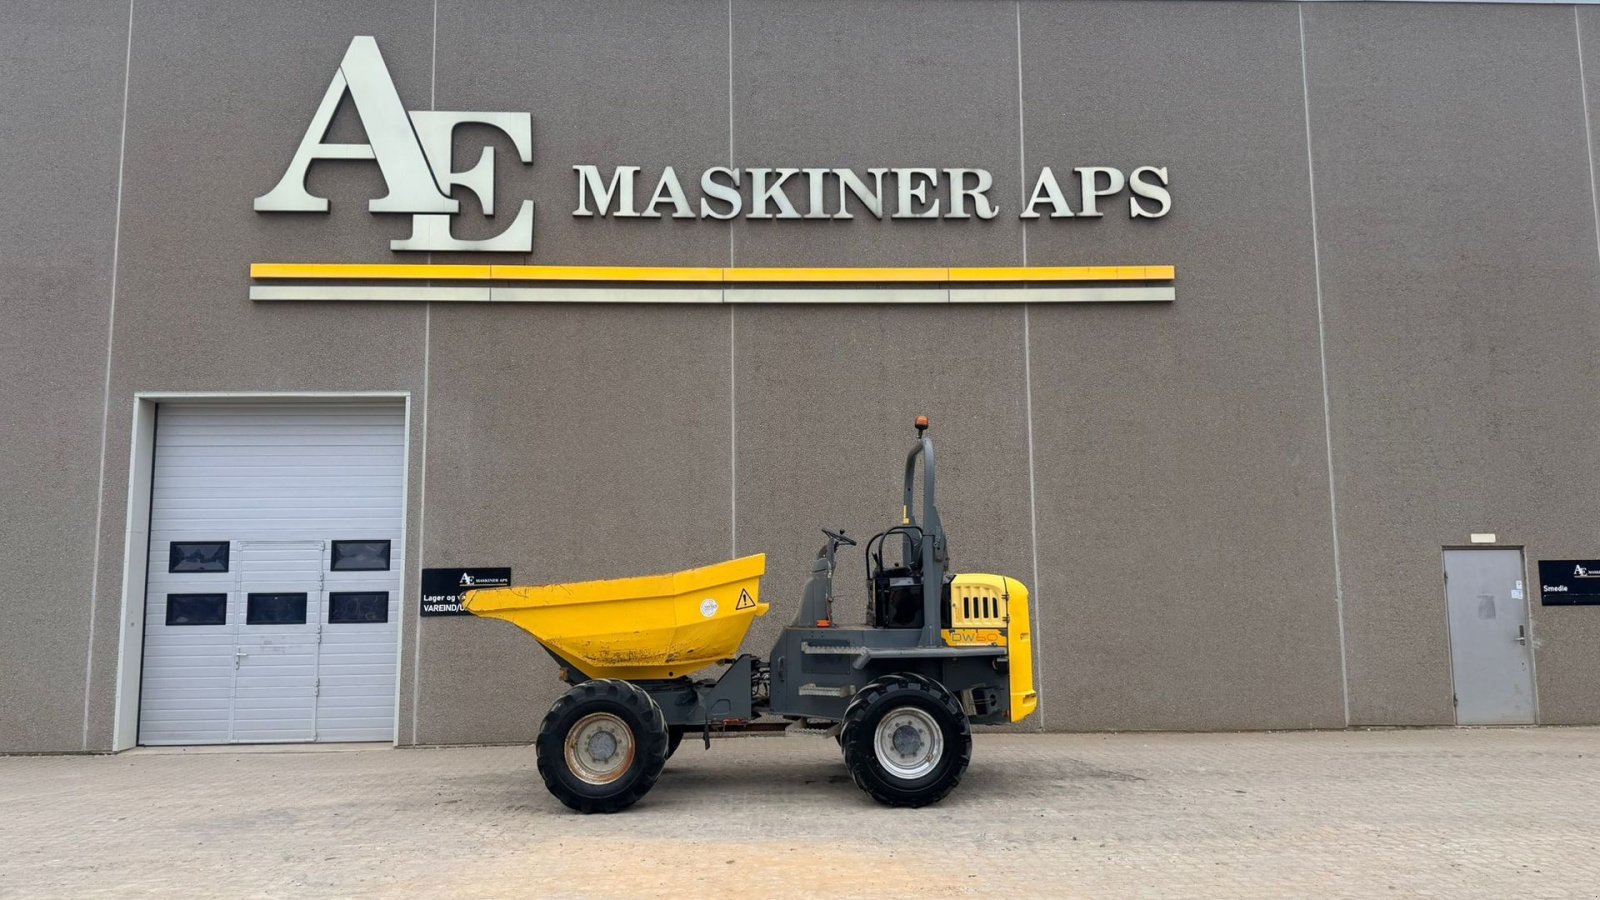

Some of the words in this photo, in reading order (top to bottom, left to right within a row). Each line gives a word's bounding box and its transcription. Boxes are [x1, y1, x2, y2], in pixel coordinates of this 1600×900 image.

[253, 35, 534, 252] AE
[572, 164, 999, 220] MASKINER
[1020, 165, 1173, 219] APS
[423, 594, 444, 603] Lager
[446, 595, 456, 603] og
[423, 604, 465, 612] VAREIND/U
